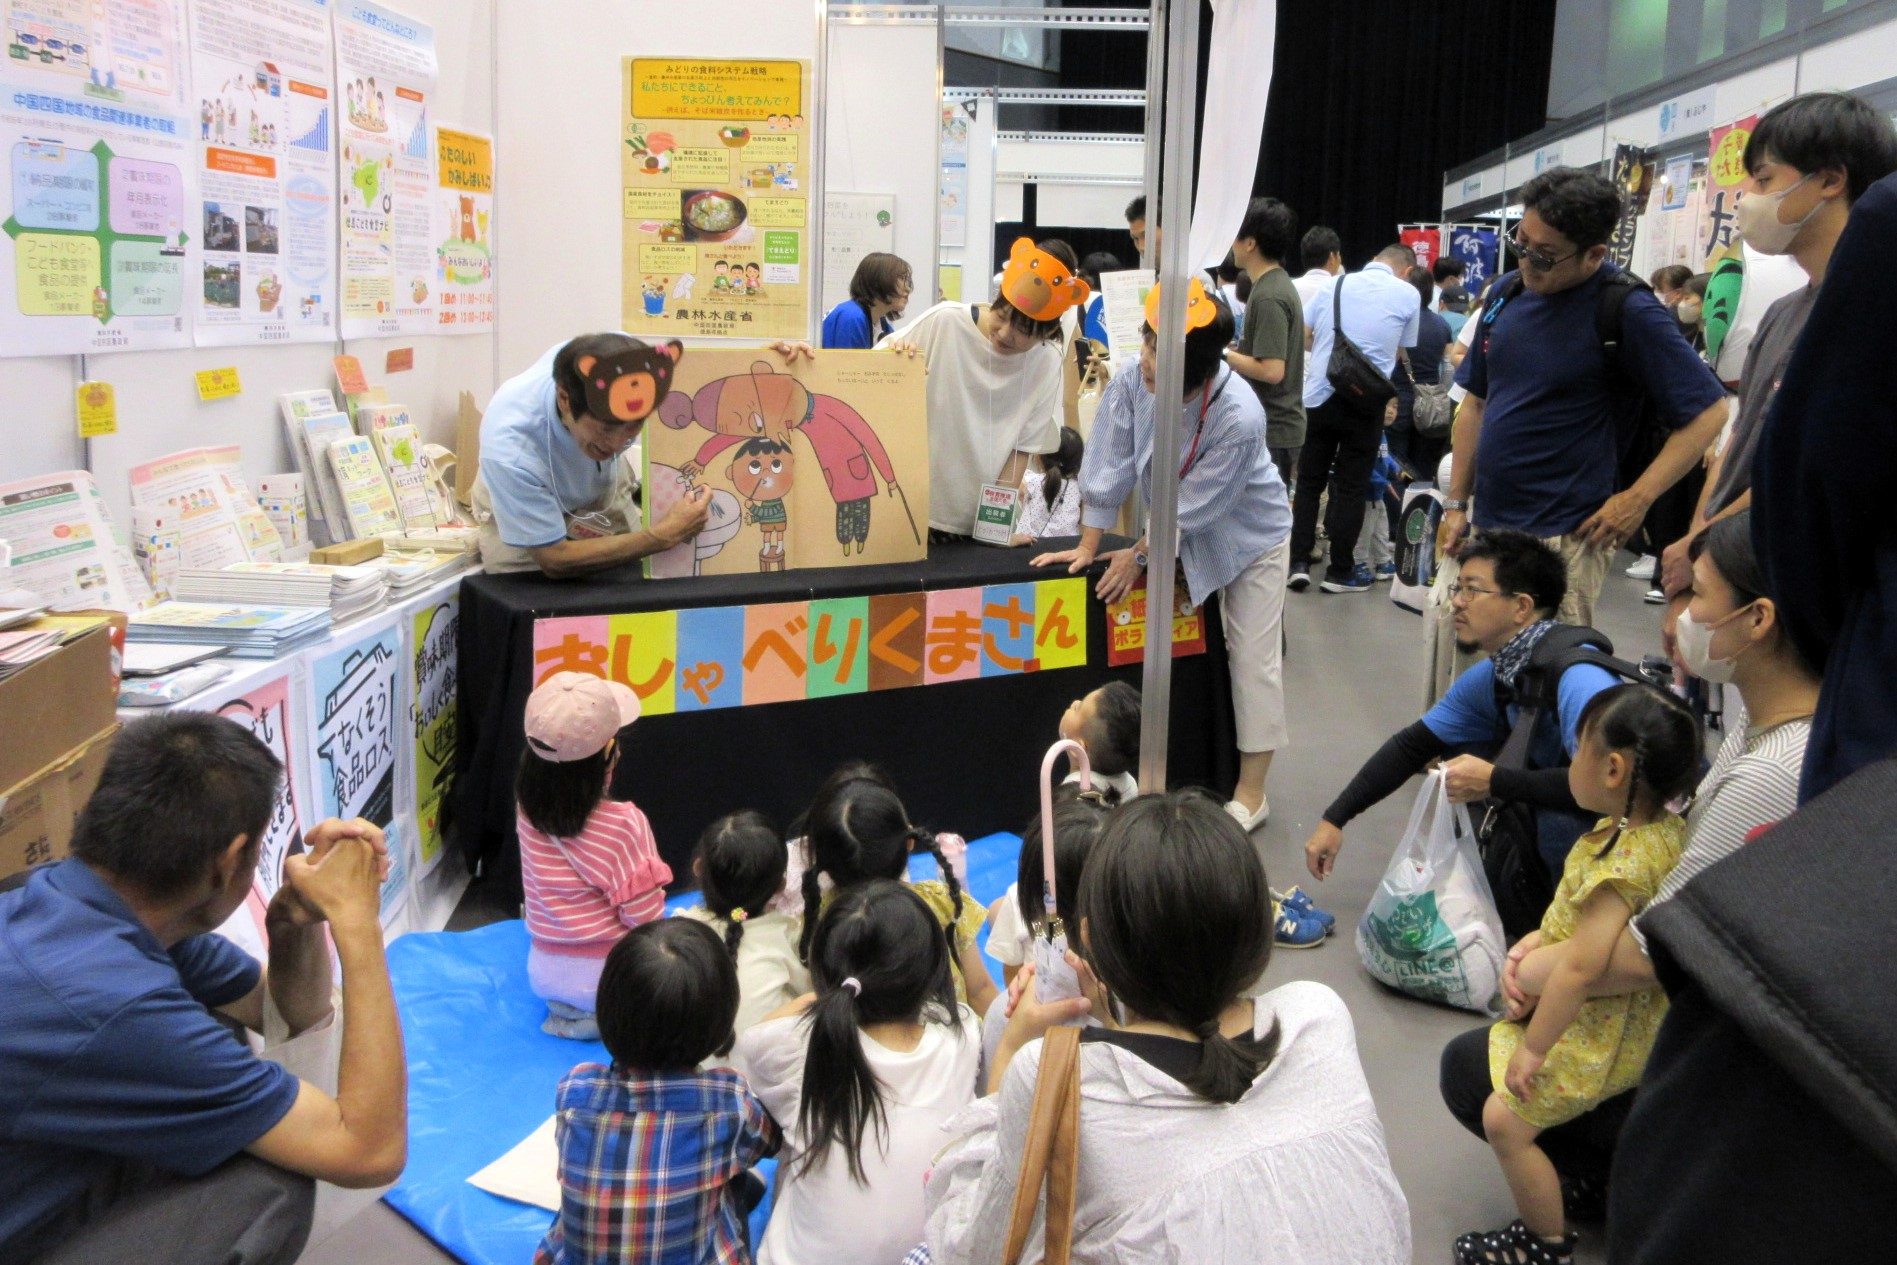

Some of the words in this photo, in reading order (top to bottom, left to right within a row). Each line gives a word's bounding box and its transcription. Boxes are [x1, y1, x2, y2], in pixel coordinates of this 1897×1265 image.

[665, 65, 767, 76] みどりの食料システム戦略
[641, 82, 727, 93] 私たちにできること、
[676, 309, 753, 322] 農林水産省
[1115, 620, 1198, 647] ボラィア
[535, 595, 1079, 704] おしゃべりくまさん
